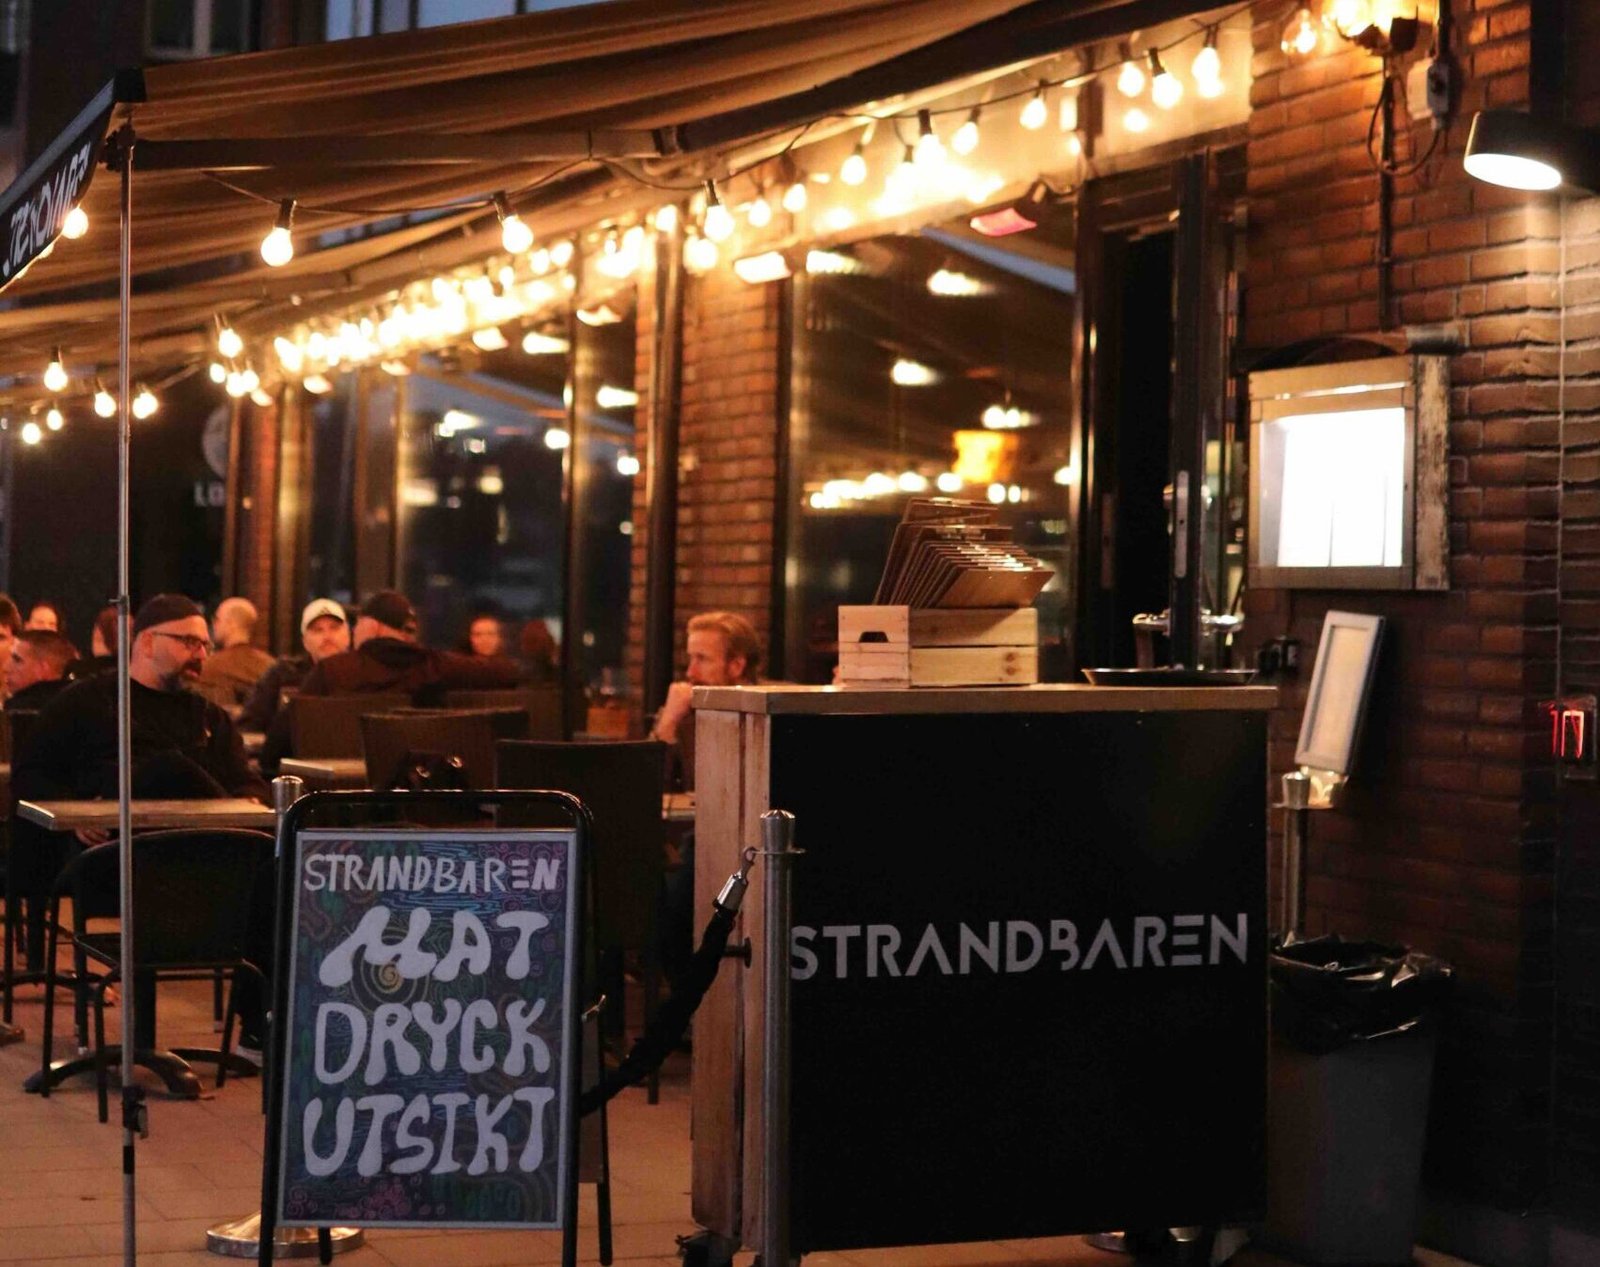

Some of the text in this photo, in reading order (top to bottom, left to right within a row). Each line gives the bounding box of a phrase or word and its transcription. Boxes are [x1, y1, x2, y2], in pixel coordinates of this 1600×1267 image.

[303, 853, 561, 895] STRANDBAREN
[318, 905, 550, 988] MAT
[790, 912, 1249, 981] STRANDBAREN
[314, 997, 551, 1086] DRYCK
[302, 1086, 555, 1178] UTSIKT
